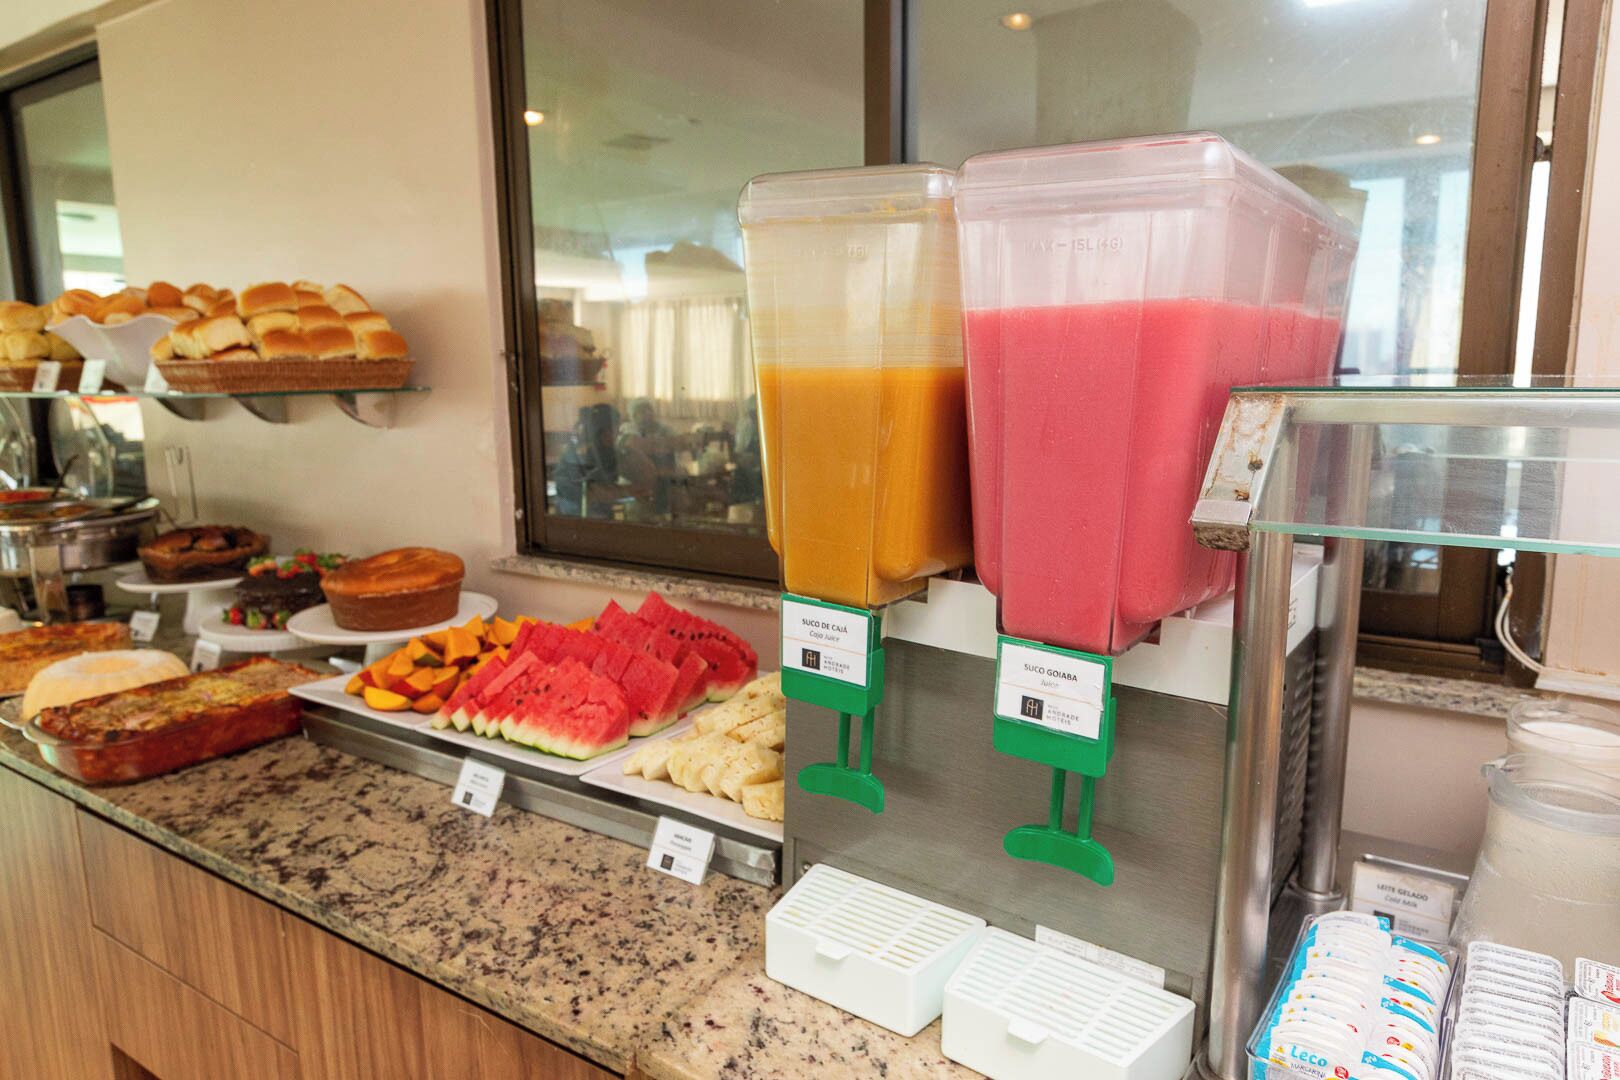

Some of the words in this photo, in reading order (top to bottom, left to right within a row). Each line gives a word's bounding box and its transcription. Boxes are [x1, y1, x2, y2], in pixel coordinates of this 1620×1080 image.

[802, 619, 820, 628] SUCO
[821, 622, 830, 630] DE
[831, 624, 848, 634] CAJÁ
[1024, 663, 1045, 675] SUCO
[1046, 669, 1078, 682] GOIABA
[1377, 883, 1395, 894] LEITE
[1398, 888, 1429, 902] GELADO
[1290, 1044, 1328, 1067] Leco
